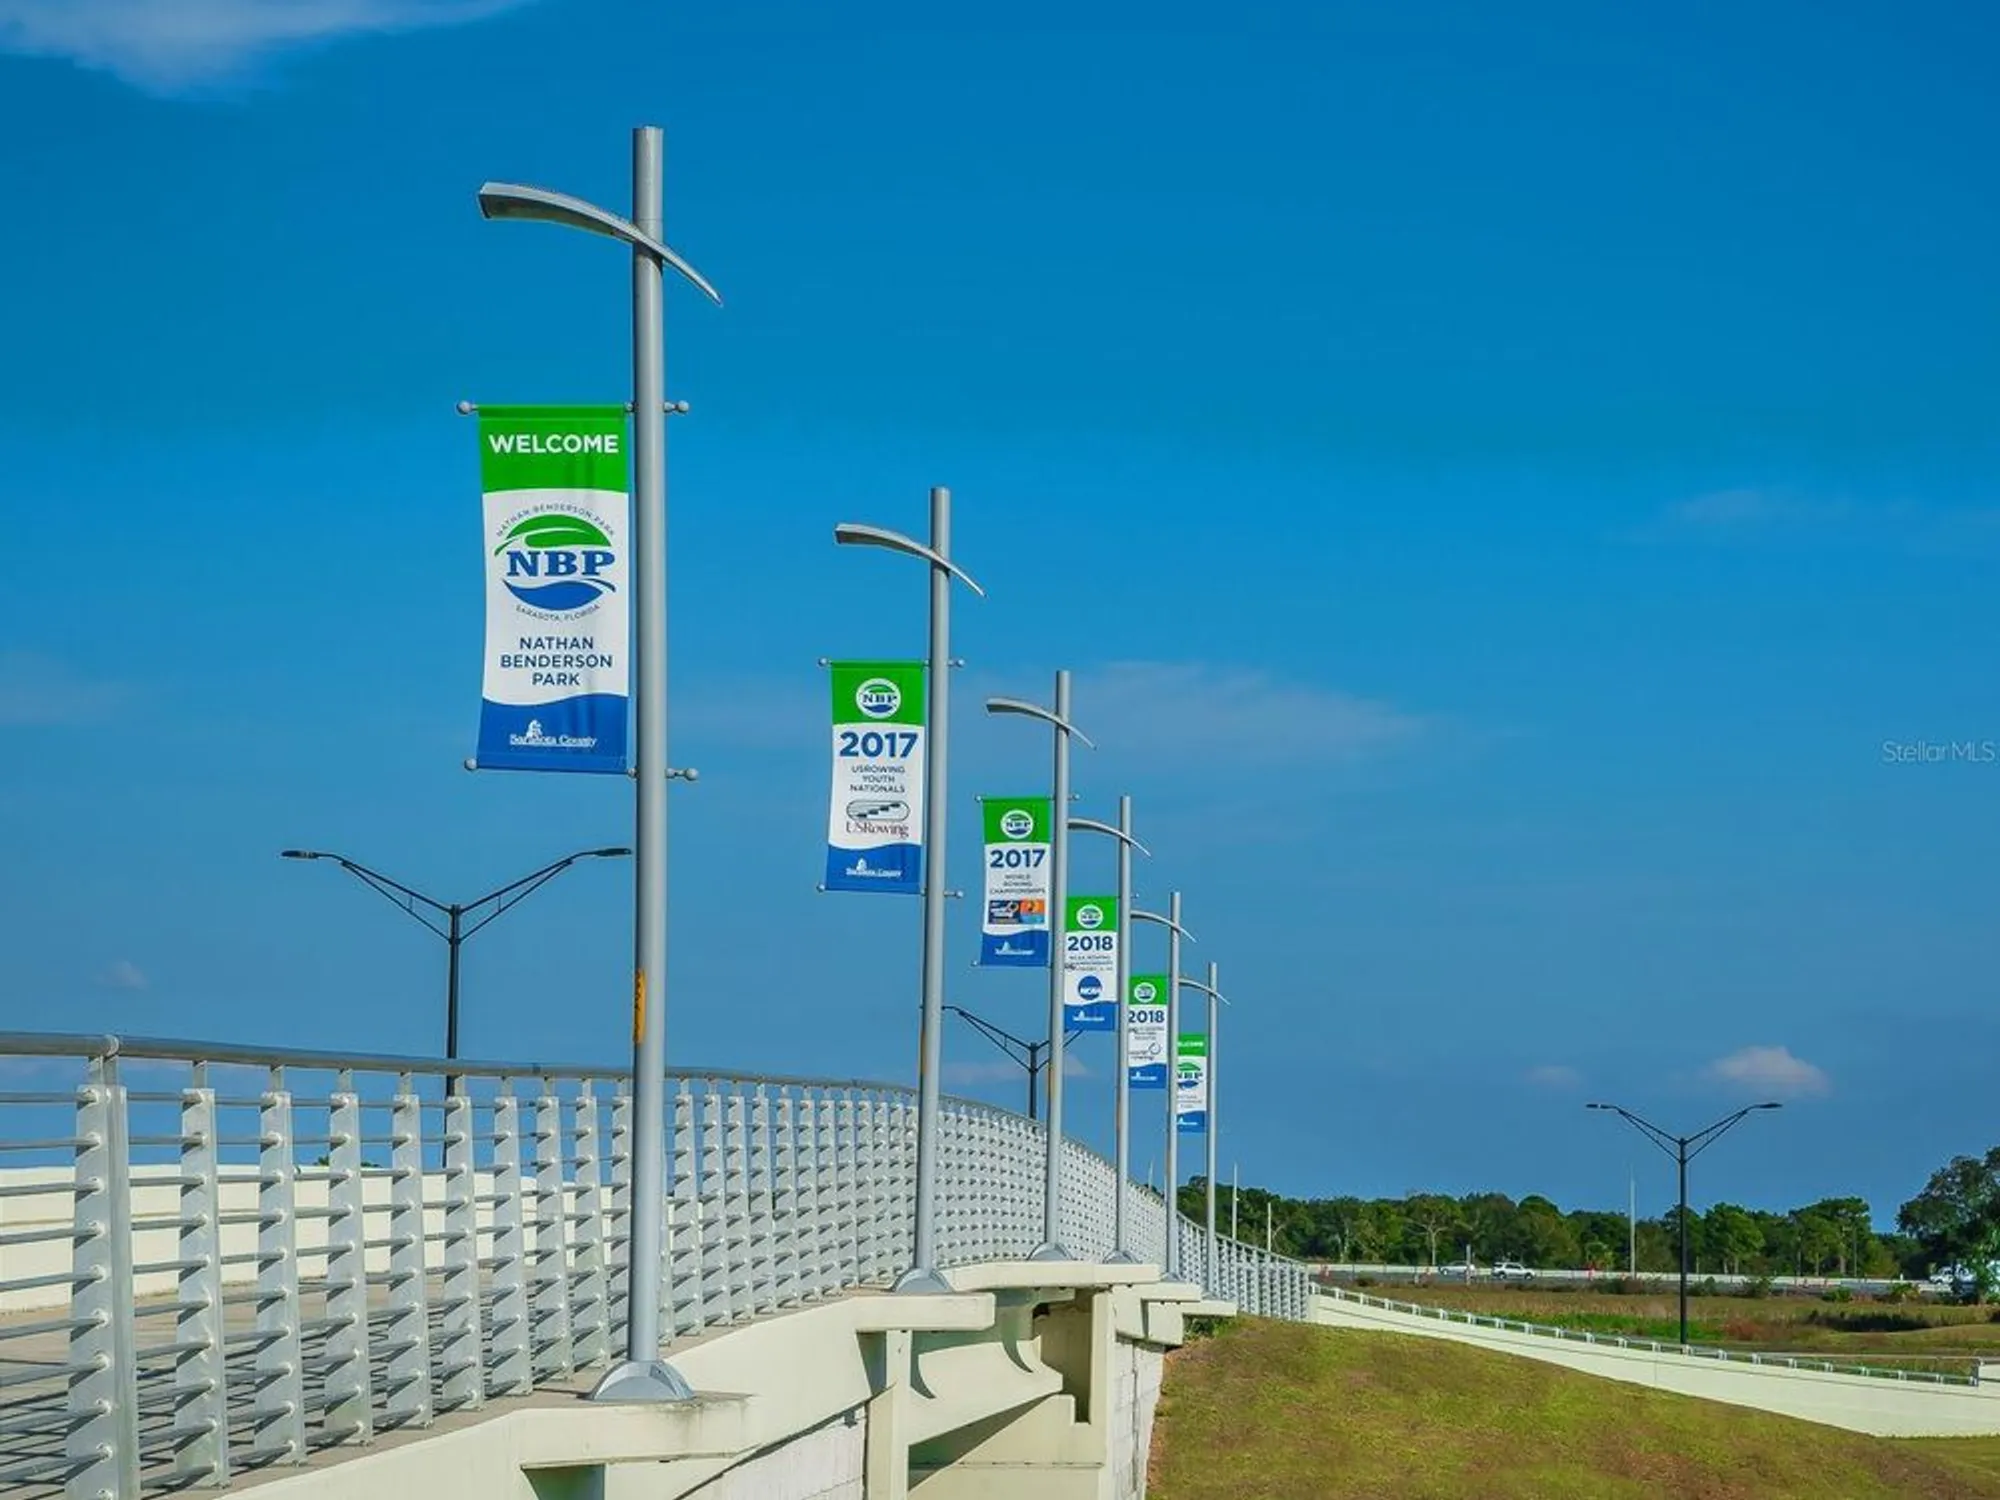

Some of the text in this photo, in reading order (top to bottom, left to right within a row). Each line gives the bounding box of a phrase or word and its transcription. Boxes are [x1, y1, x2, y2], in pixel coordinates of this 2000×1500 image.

[488, 434, 619, 453] WELCOME
[496, 503, 614, 537] NATHAN BENDERSON PARK
[506, 550, 615, 577] NBP
[564, 604, 600, 620] FLORIDA
[519, 636, 594, 650] NATHAN
[500, 654, 613, 668] BENDERSON
[532, 672, 580, 686] PARK
[862, 694, 897, 703] NBP
[840, 731, 919, 758] 2017
[851, 765, 905, 774] USROWING
[862, 775, 895, 783] YOUTH
[850, 784, 905, 793] NATIONALS
[846, 821, 909, 839] USRowing
[990, 848, 1045, 868] 2017
[1068, 936, 1113, 951] 2018
[1128, 1010, 1165, 1023] 2018
